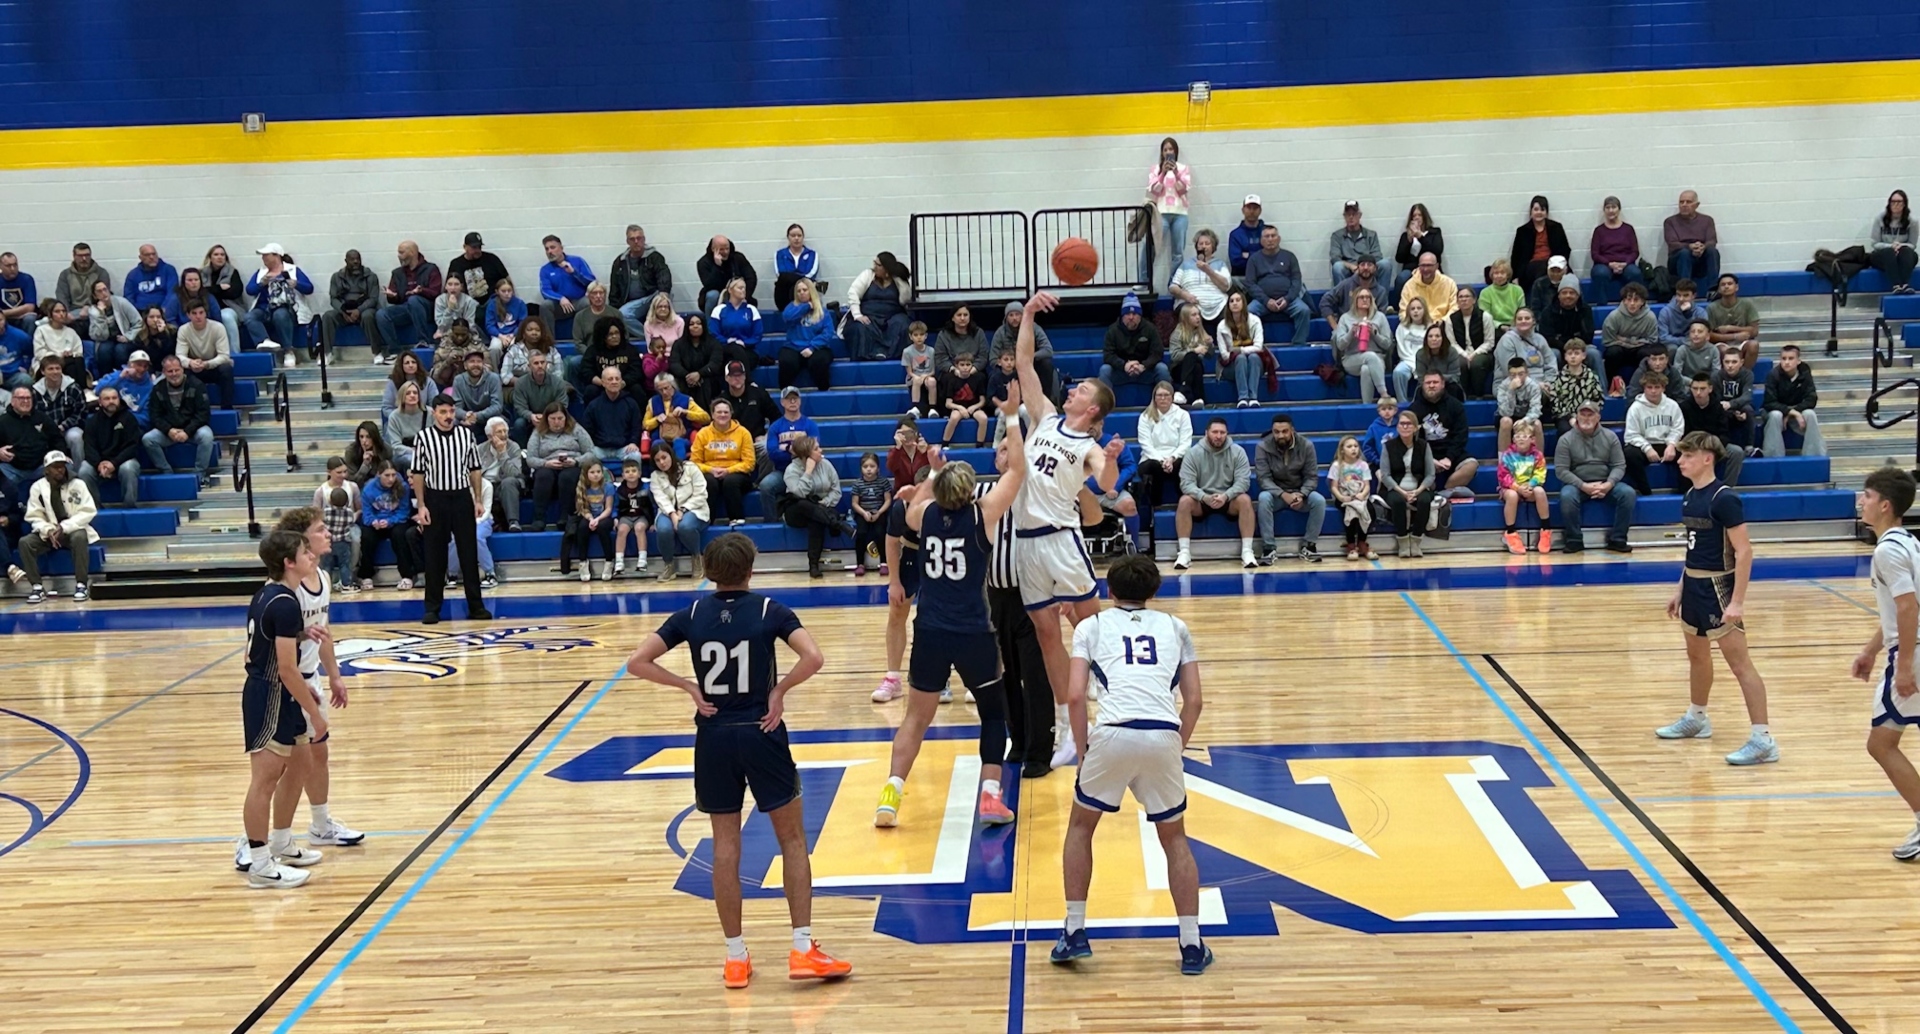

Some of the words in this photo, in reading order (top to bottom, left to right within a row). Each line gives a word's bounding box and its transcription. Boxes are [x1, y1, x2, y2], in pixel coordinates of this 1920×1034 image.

[1033, 437, 1078, 465] VIKINGS
[1034, 453, 1059, 477] 42
[924, 536, 967, 581] 35
[1122, 634, 1158, 665] 13
[700, 639, 749, 695] 21
